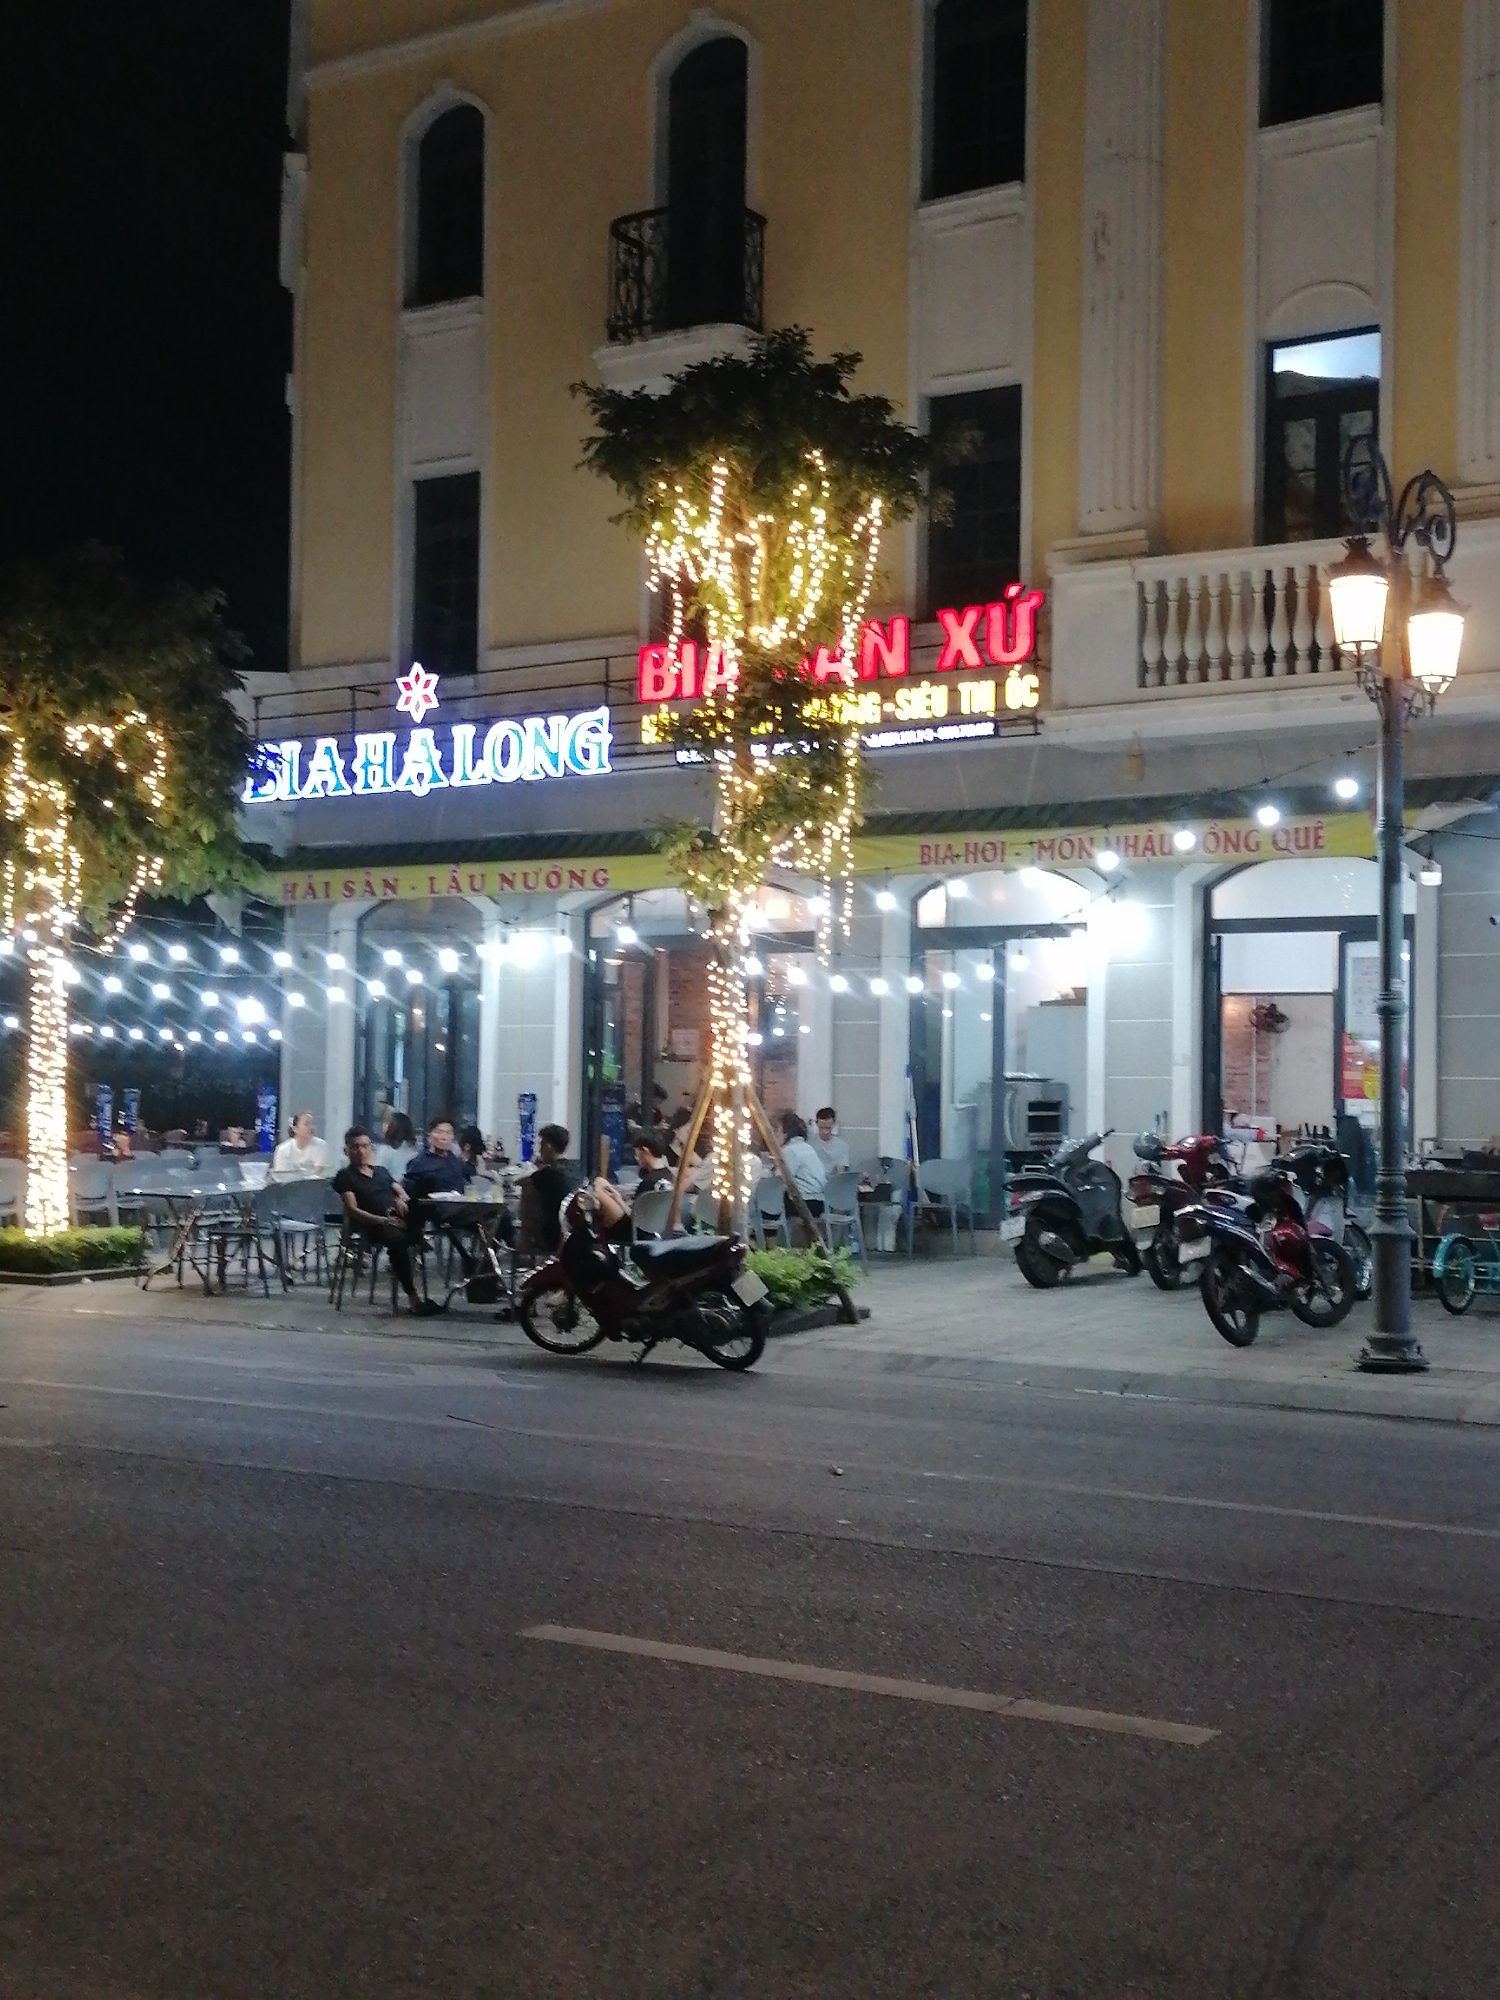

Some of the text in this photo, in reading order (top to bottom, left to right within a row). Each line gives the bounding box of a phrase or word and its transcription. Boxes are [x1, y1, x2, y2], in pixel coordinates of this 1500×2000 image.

[638, 640, 741, 703] BIA
[936, 583, 1044, 672] XỨ
[1178, 822, 1261, 854] ỒNG
[1271, 819, 1325, 854] QUÊ
[282, 874, 331, 900] HẢI
[342, 871, 399, 898] SẢN
